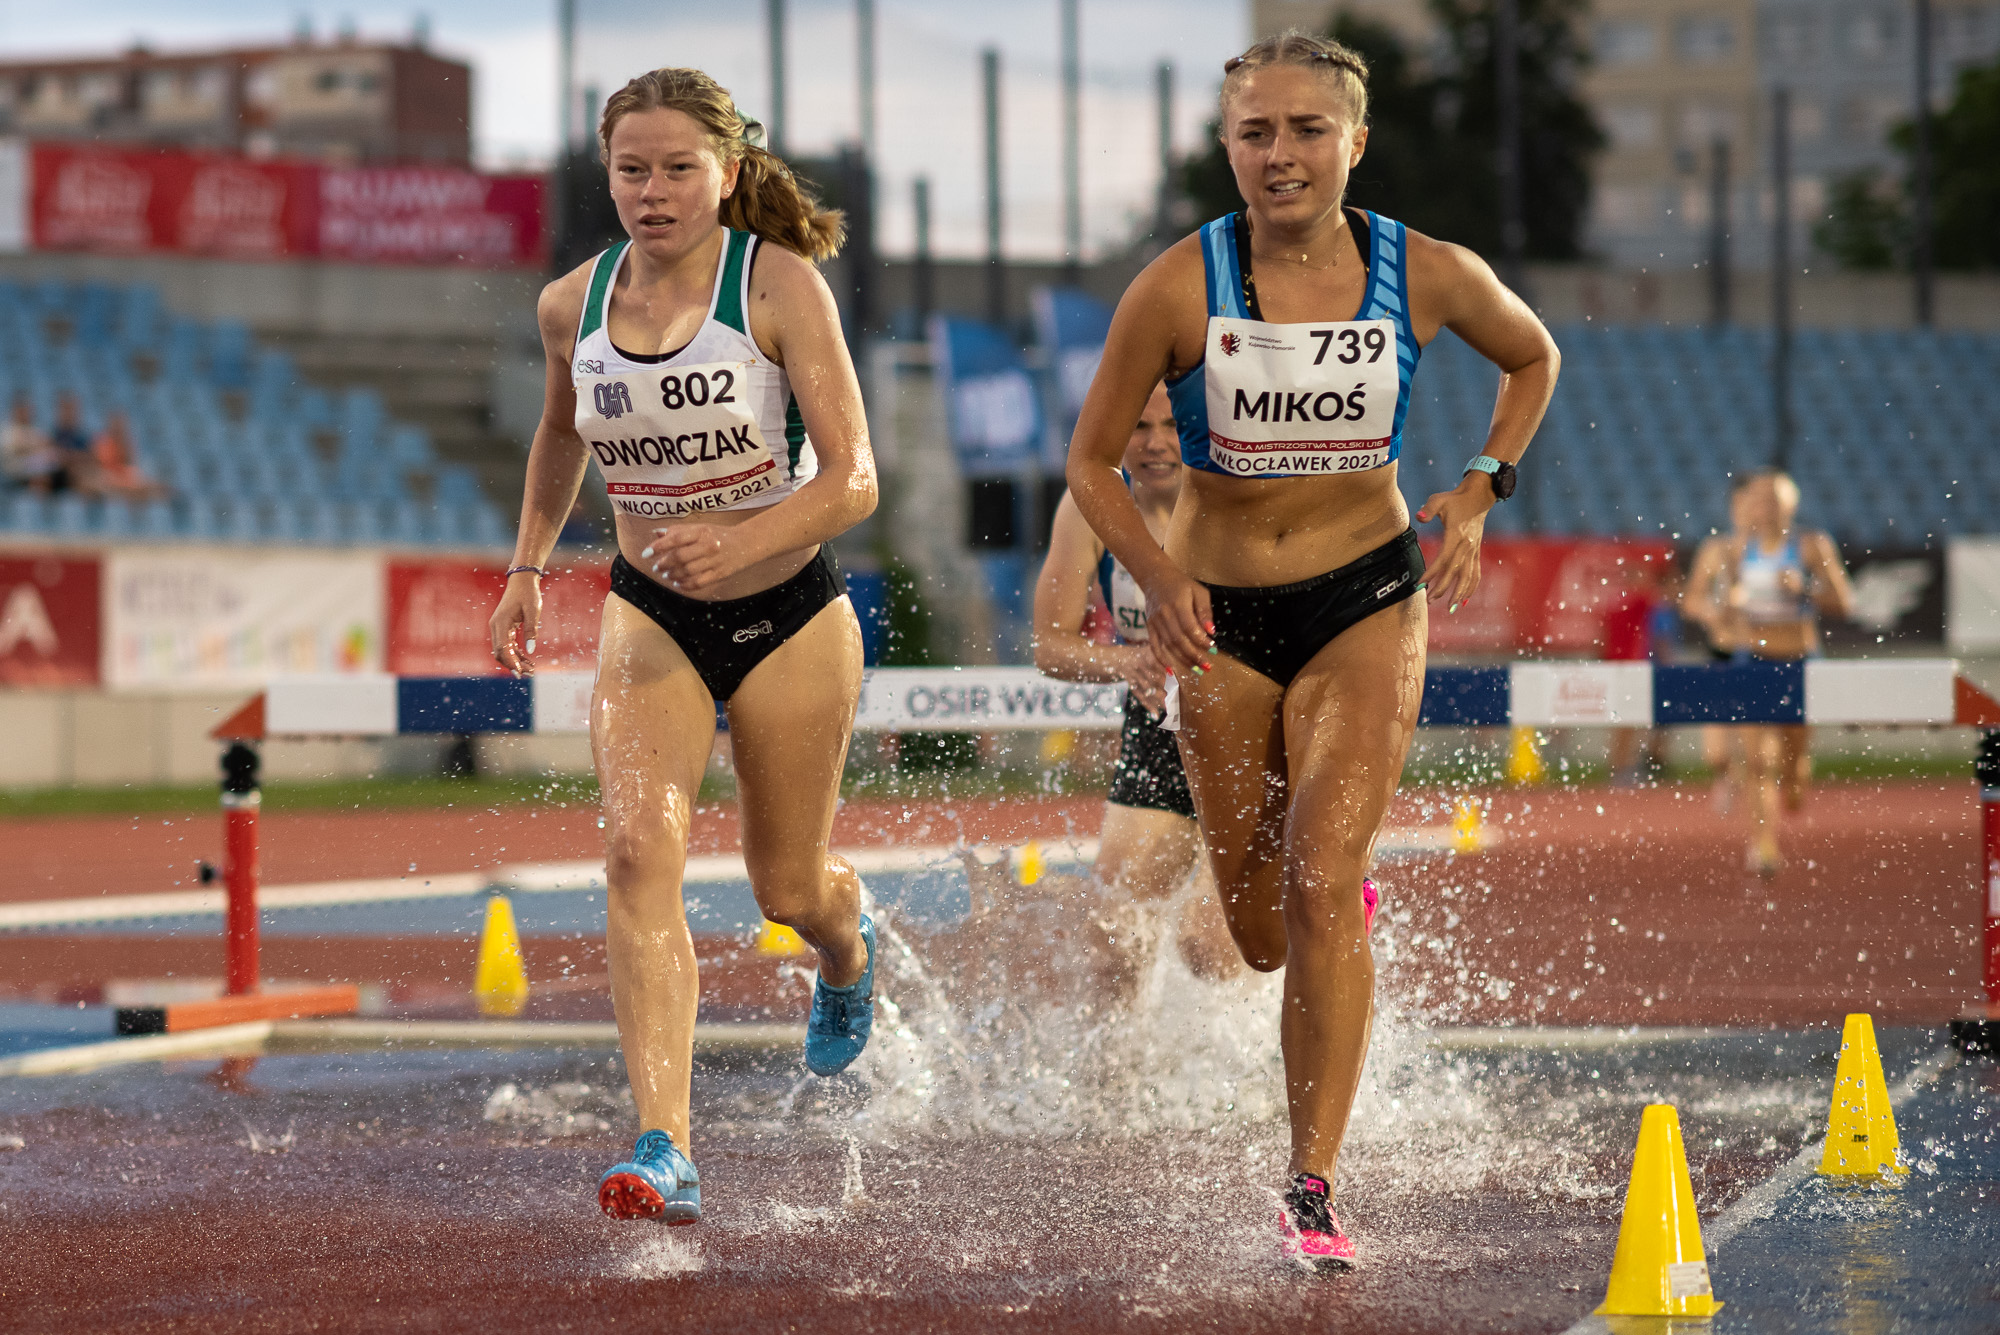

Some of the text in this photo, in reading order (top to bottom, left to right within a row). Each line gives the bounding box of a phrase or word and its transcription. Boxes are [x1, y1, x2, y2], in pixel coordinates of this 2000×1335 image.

[1309, 328, 1386, 366] 739
[660, 369, 736, 410] 802
[1233, 382, 1367, 423] MIKOŚ
[591, 424, 760, 467] DWORCZAK
[1214, 447, 1378, 473] WŁOCŁAWEK 2021
[1226, 441, 1253, 451] PZLA
[1254, 442, 1328, 451] MISTRZOSTWA
[1329, 441, 1365, 449] POLSKI
[1366, 440, 1384, 448] U18
[613, 485, 628, 493] 53.
[628, 485, 651, 494] PZLA
[651, 482, 714, 495] MISTRZOSTWA
[714, 473, 749, 487] POLSKI
[617, 475, 772, 516] WŁOCŁAWEK 2021
[905, 684, 991, 718] OSIR
